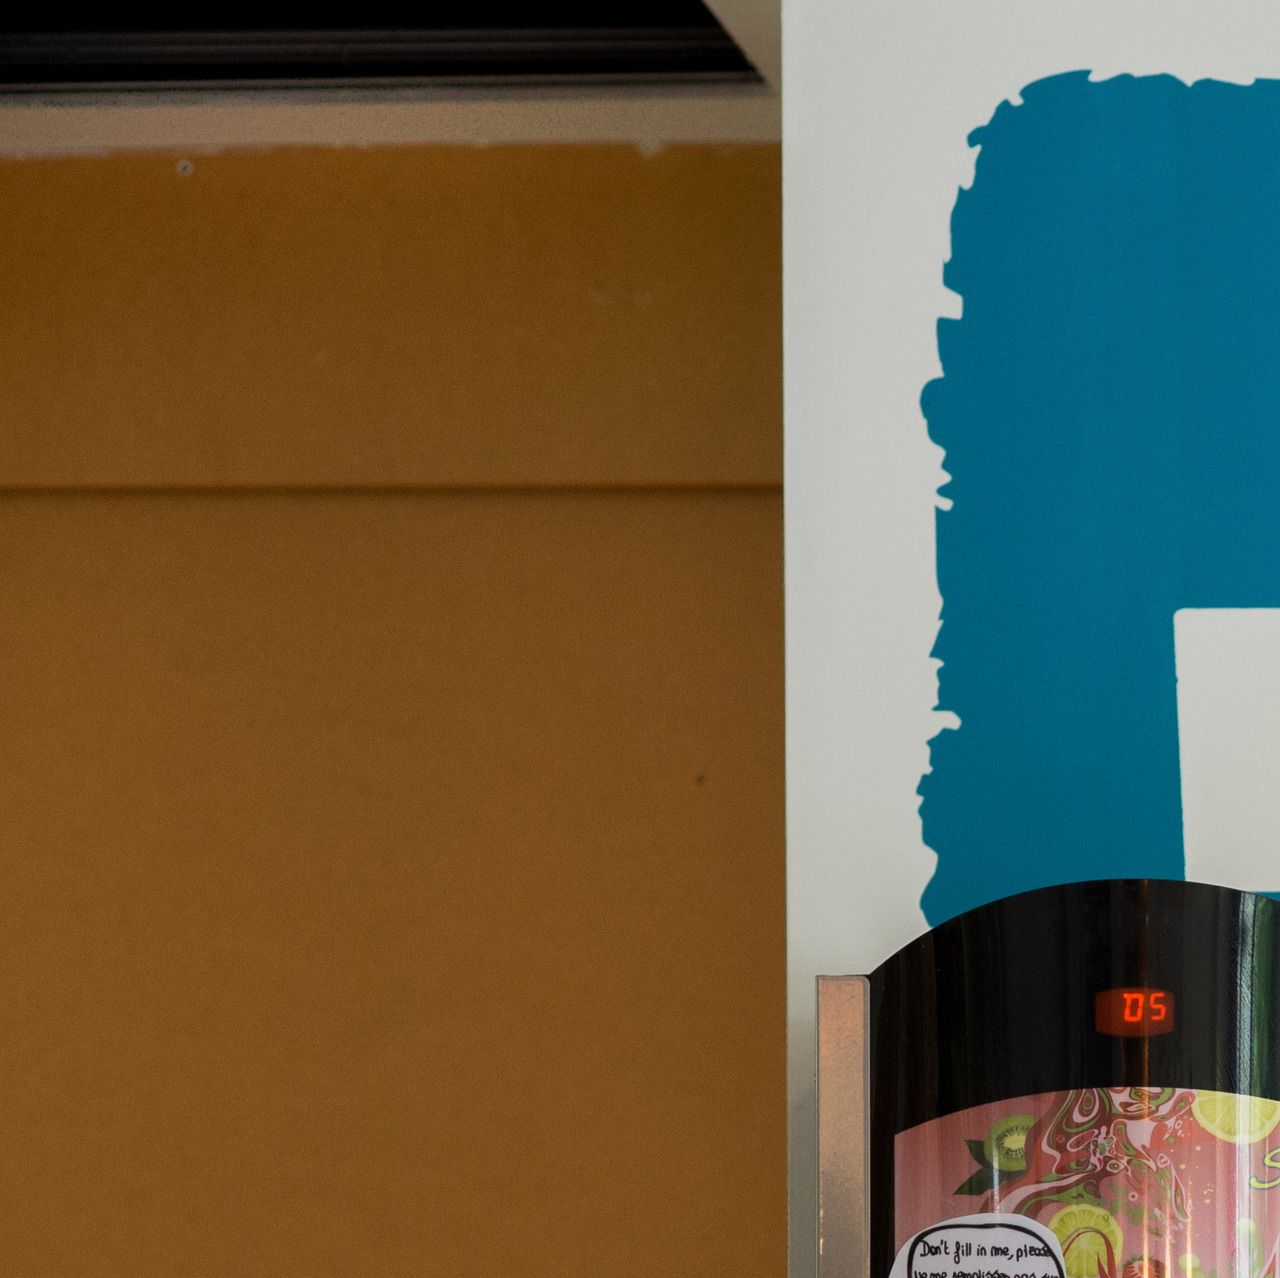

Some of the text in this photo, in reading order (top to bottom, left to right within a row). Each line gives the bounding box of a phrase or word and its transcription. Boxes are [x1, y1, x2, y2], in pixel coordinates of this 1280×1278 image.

[919, 1239, 950, 1257] Don't
[954, 1241, 972, 1264] fill
[977, 1244, 987, 1256] in
[990, 1247, 1013, 1260] me,
